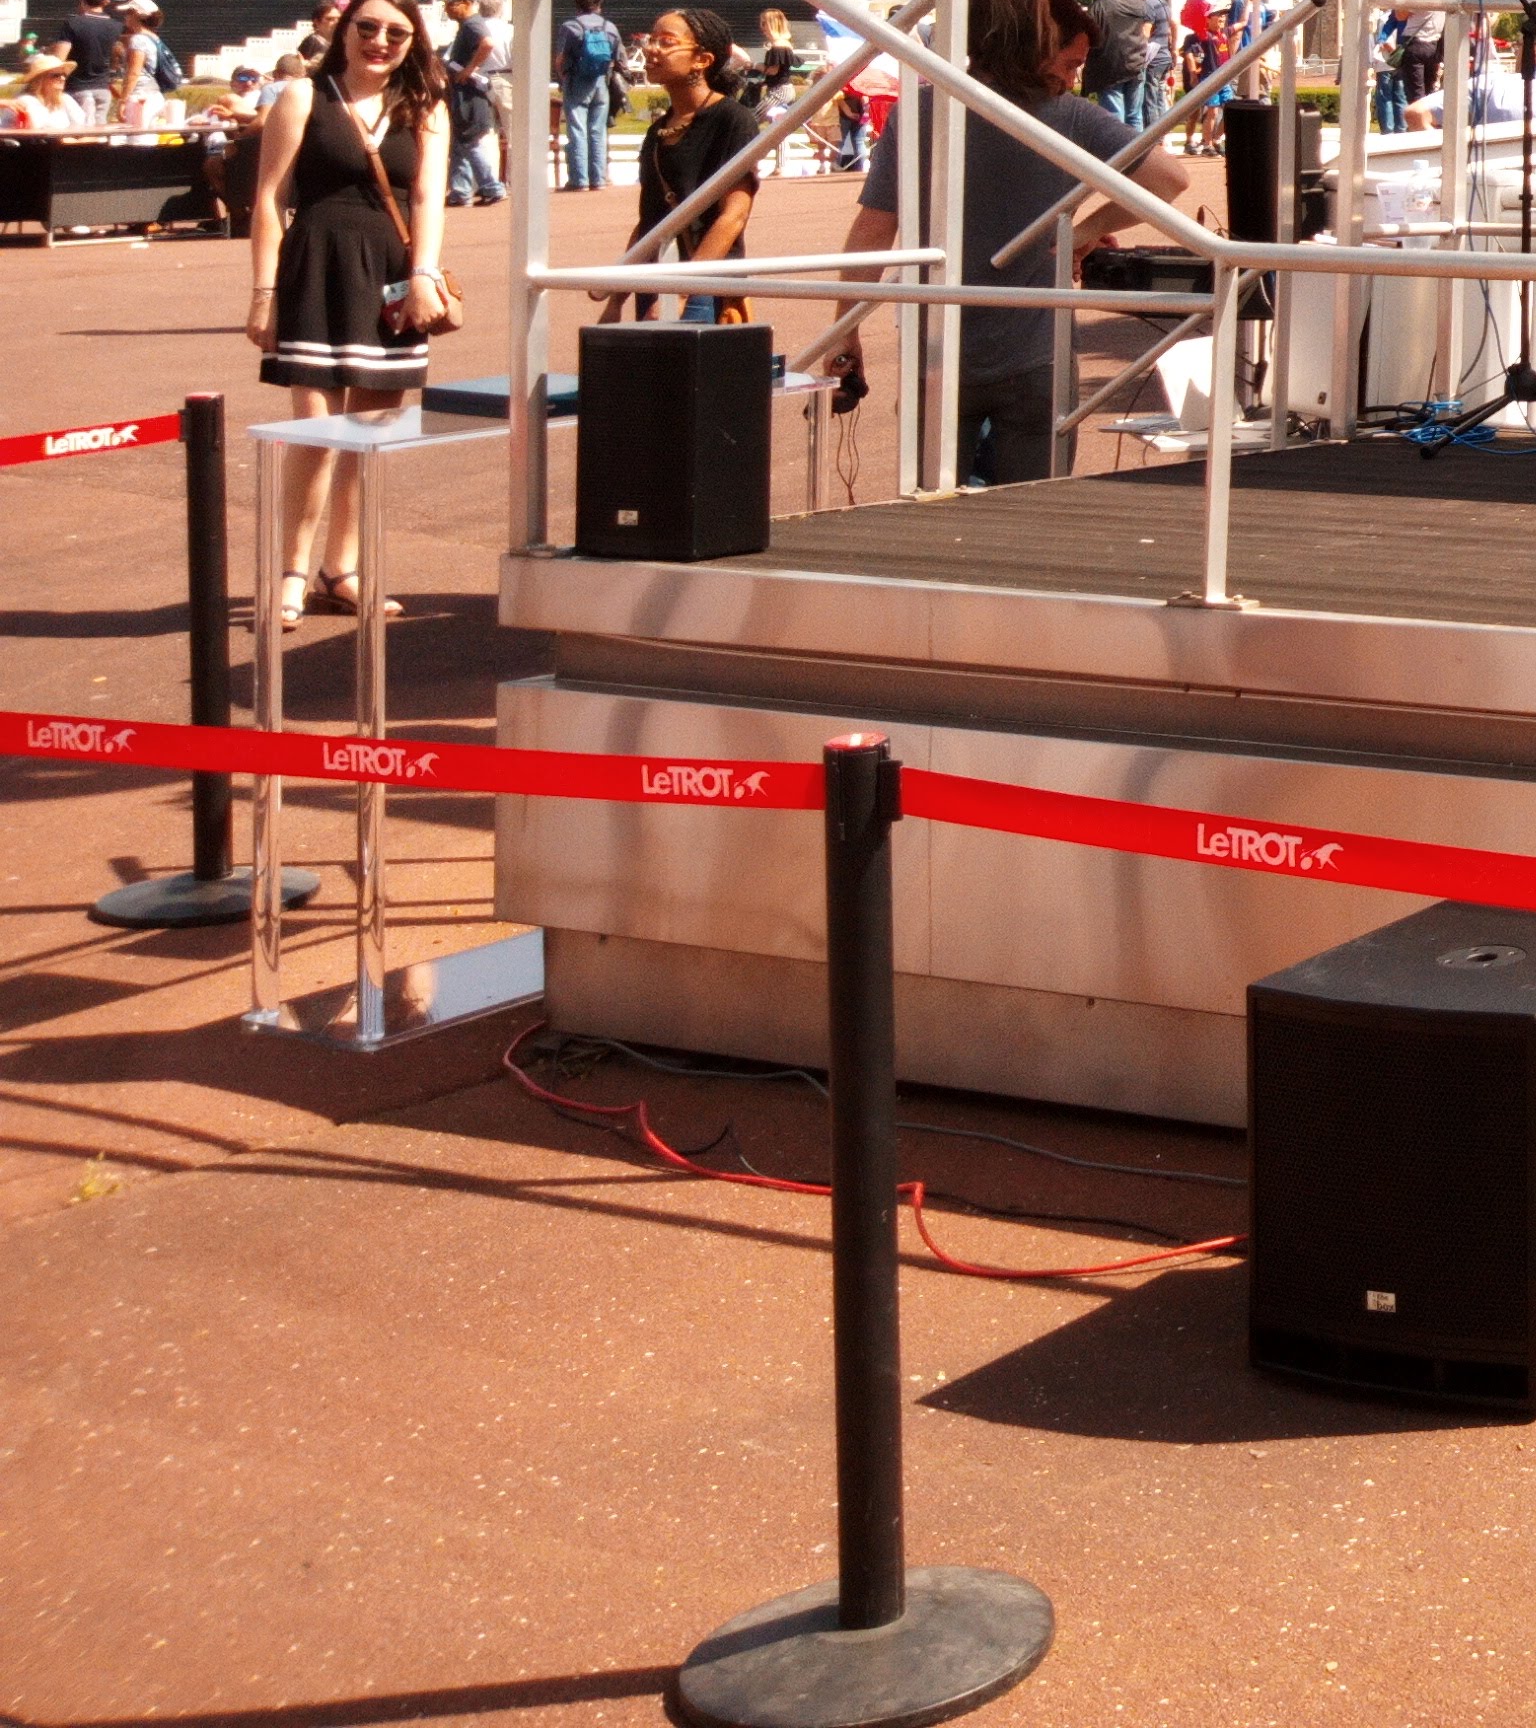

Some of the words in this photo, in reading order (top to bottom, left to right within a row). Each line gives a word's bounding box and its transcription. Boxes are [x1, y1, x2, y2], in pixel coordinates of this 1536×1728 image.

[45, 427, 115, 456] LeTROT
[27, 720, 106, 752] LeTROT
[323, 742, 407, 776] LeTROT
[641, 764, 734, 798] LeTROT
[1197, 823, 1303, 868] LeTROT
